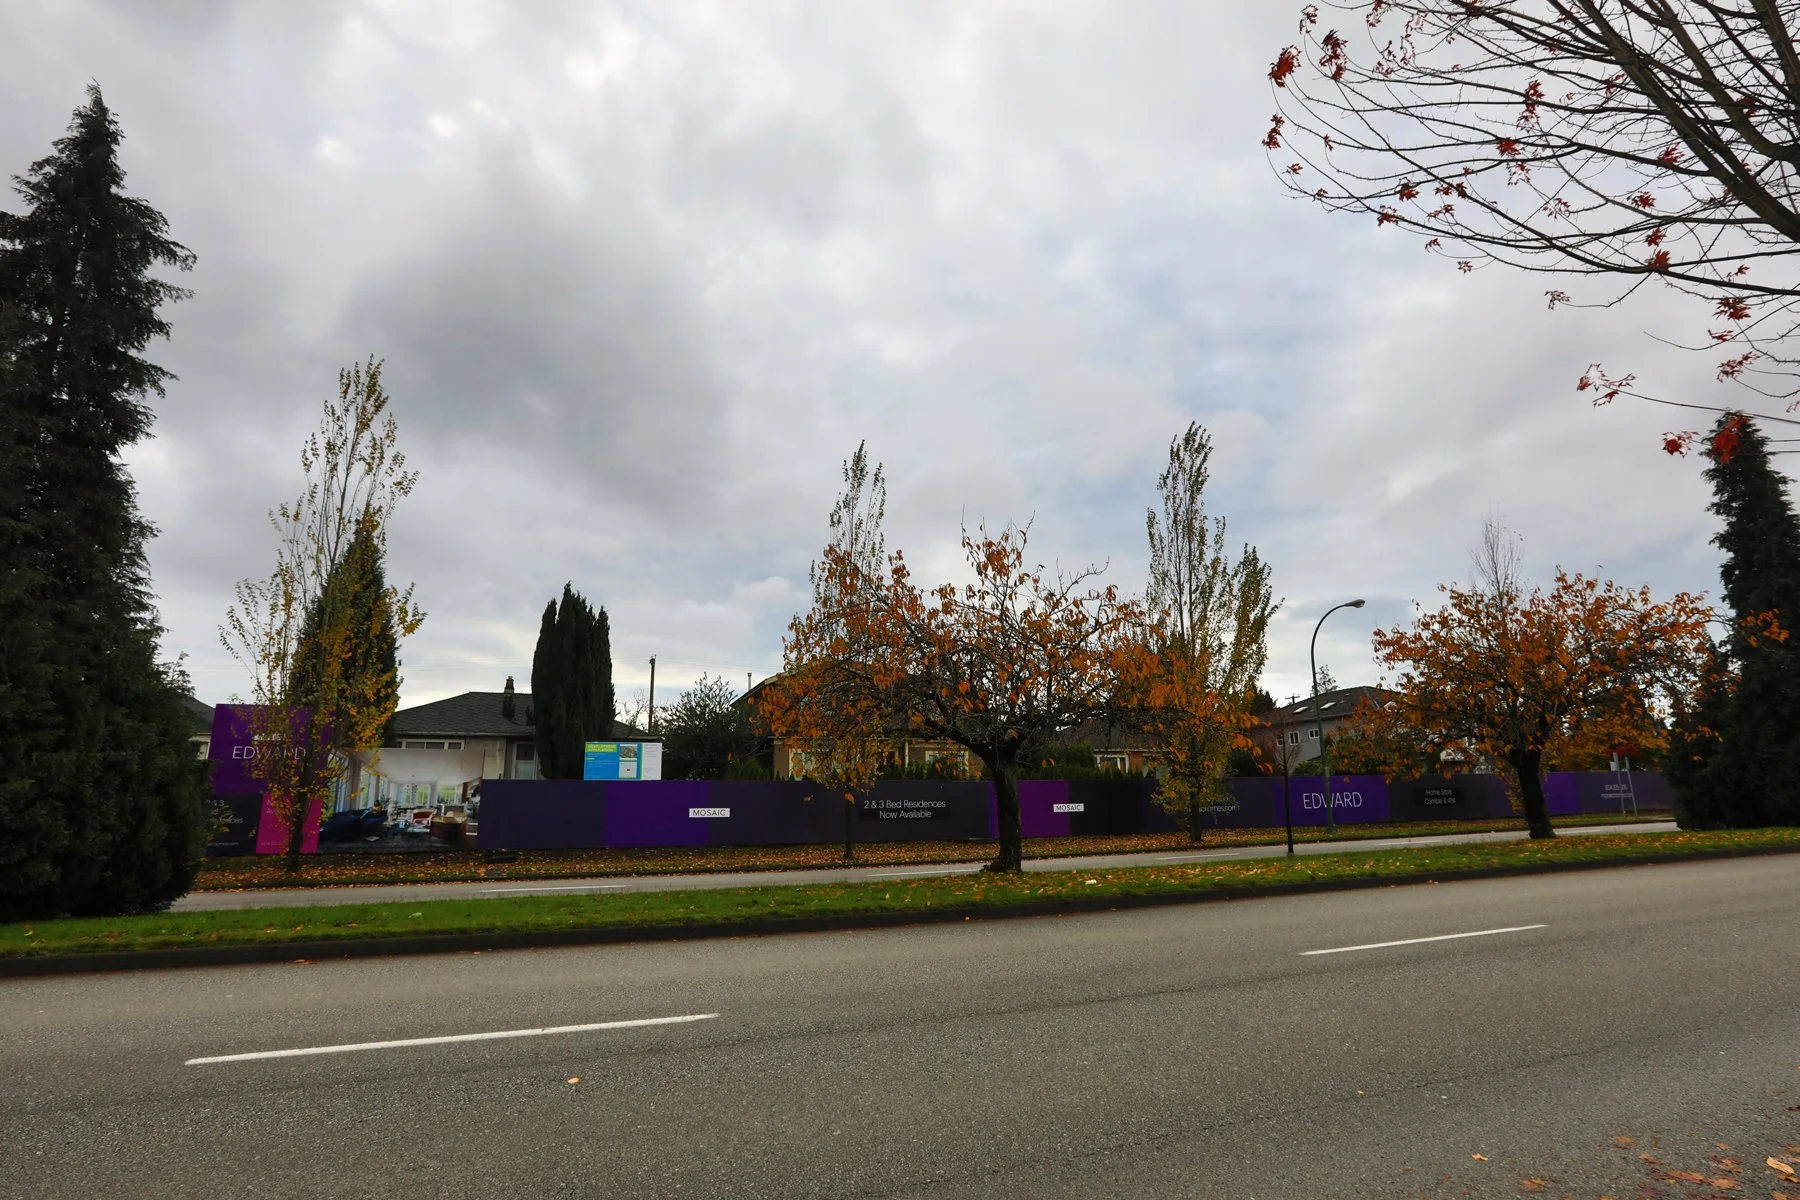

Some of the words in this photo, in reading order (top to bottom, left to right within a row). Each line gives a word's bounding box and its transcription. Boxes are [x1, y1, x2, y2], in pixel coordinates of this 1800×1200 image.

[864, 800, 869, 809] 2
[871, 800, 877, 809] &
[879, 800, 885, 809] 3
[886, 799, 901, 809] Bed
[903, 799, 946, 809] Residences
[1302, 791, 1362, 809] EDWARD
[692, 808, 726, 817] MOSAIC
[880, 810, 897, 819] Now
[899, 809, 932, 819] Available
